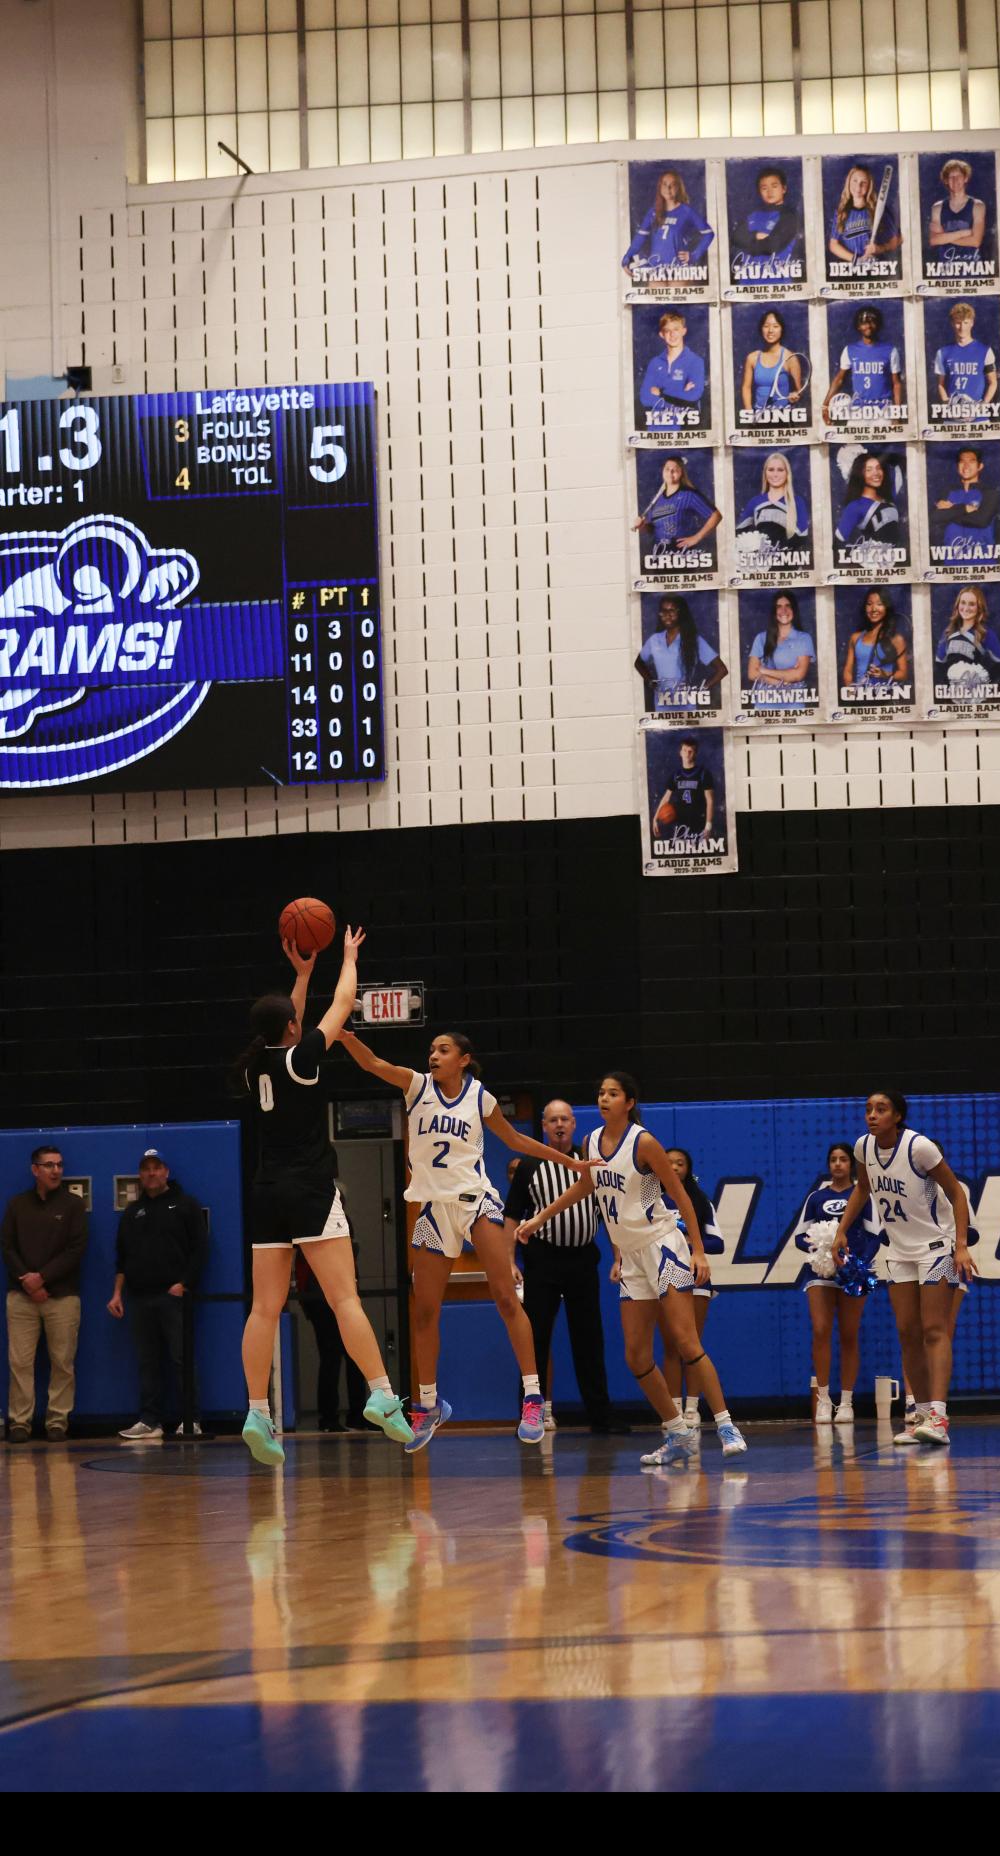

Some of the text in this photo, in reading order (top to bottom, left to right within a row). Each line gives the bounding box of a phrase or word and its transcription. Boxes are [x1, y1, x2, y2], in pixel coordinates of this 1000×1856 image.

[661, 225, 669, 240] 7
[633, 266, 707, 281] STRAYHORN
[734, 263, 802, 279] HUANG
[829, 261, 897, 276] DEMPSEY
[926, 261, 995, 277] KAUFMAN
[637, 288, 671, 296] LADUE
[831, 282, 898, 291] LADUE RAMS
[854, 361, 884, 374] LADUE
[864, 378, 870, 389] 3
[954, 378, 968, 389] 47
[195, 389, 314, 417] Lafayette
[931, 402, 1000, 418] PROSKEY
[645, 411, 700, 425] KEYS
[739, 408, 807, 423] SONG
[174, 420, 190, 443] 3
[203, 420, 271, 440] FOULS
[197, 444, 271, 464] BONUS
[309, 425, 347, 483] 5
[175, 467, 191, 491] 4
[232, 467, 271, 486] TOL
[0, 479, 84, 507] arter: 1
[645, 552, 712, 569] CROSS
[838, 548, 907, 564] LOYND
[646, 575, 680, 583] LADUE
[293, 592, 305, 609] #
[320, 587, 347, 607] PT
[295, 619, 374, 643] 0 3 0
[292, 650, 375, 672] 11 0 0
[292, 682, 376, 704] 14 0 0
[658, 690, 711, 706] KING
[741, 688, 819, 704] STOCKWELL
[840, 685, 911, 701] CHEN
[939, 705, 973, 713] LADUE
[292, 716, 372, 737] 33 0 1
[293, 748, 376, 770] 12 0 0
[653, 838, 724, 855] OLDHAM
[658, 858, 722, 868] LADUE RAMS
[371, 991, 402, 1019] EXIT
[259, 1073, 274, 1112] 0
[417, 1113, 471, 1143] LADUE
[432, 1141, 451, 1168] 2
[595, 1170, 626, 1194] ADUE
[603, 1195, 618, 1224] 14
[879, 1198, 907, 1222] 24
